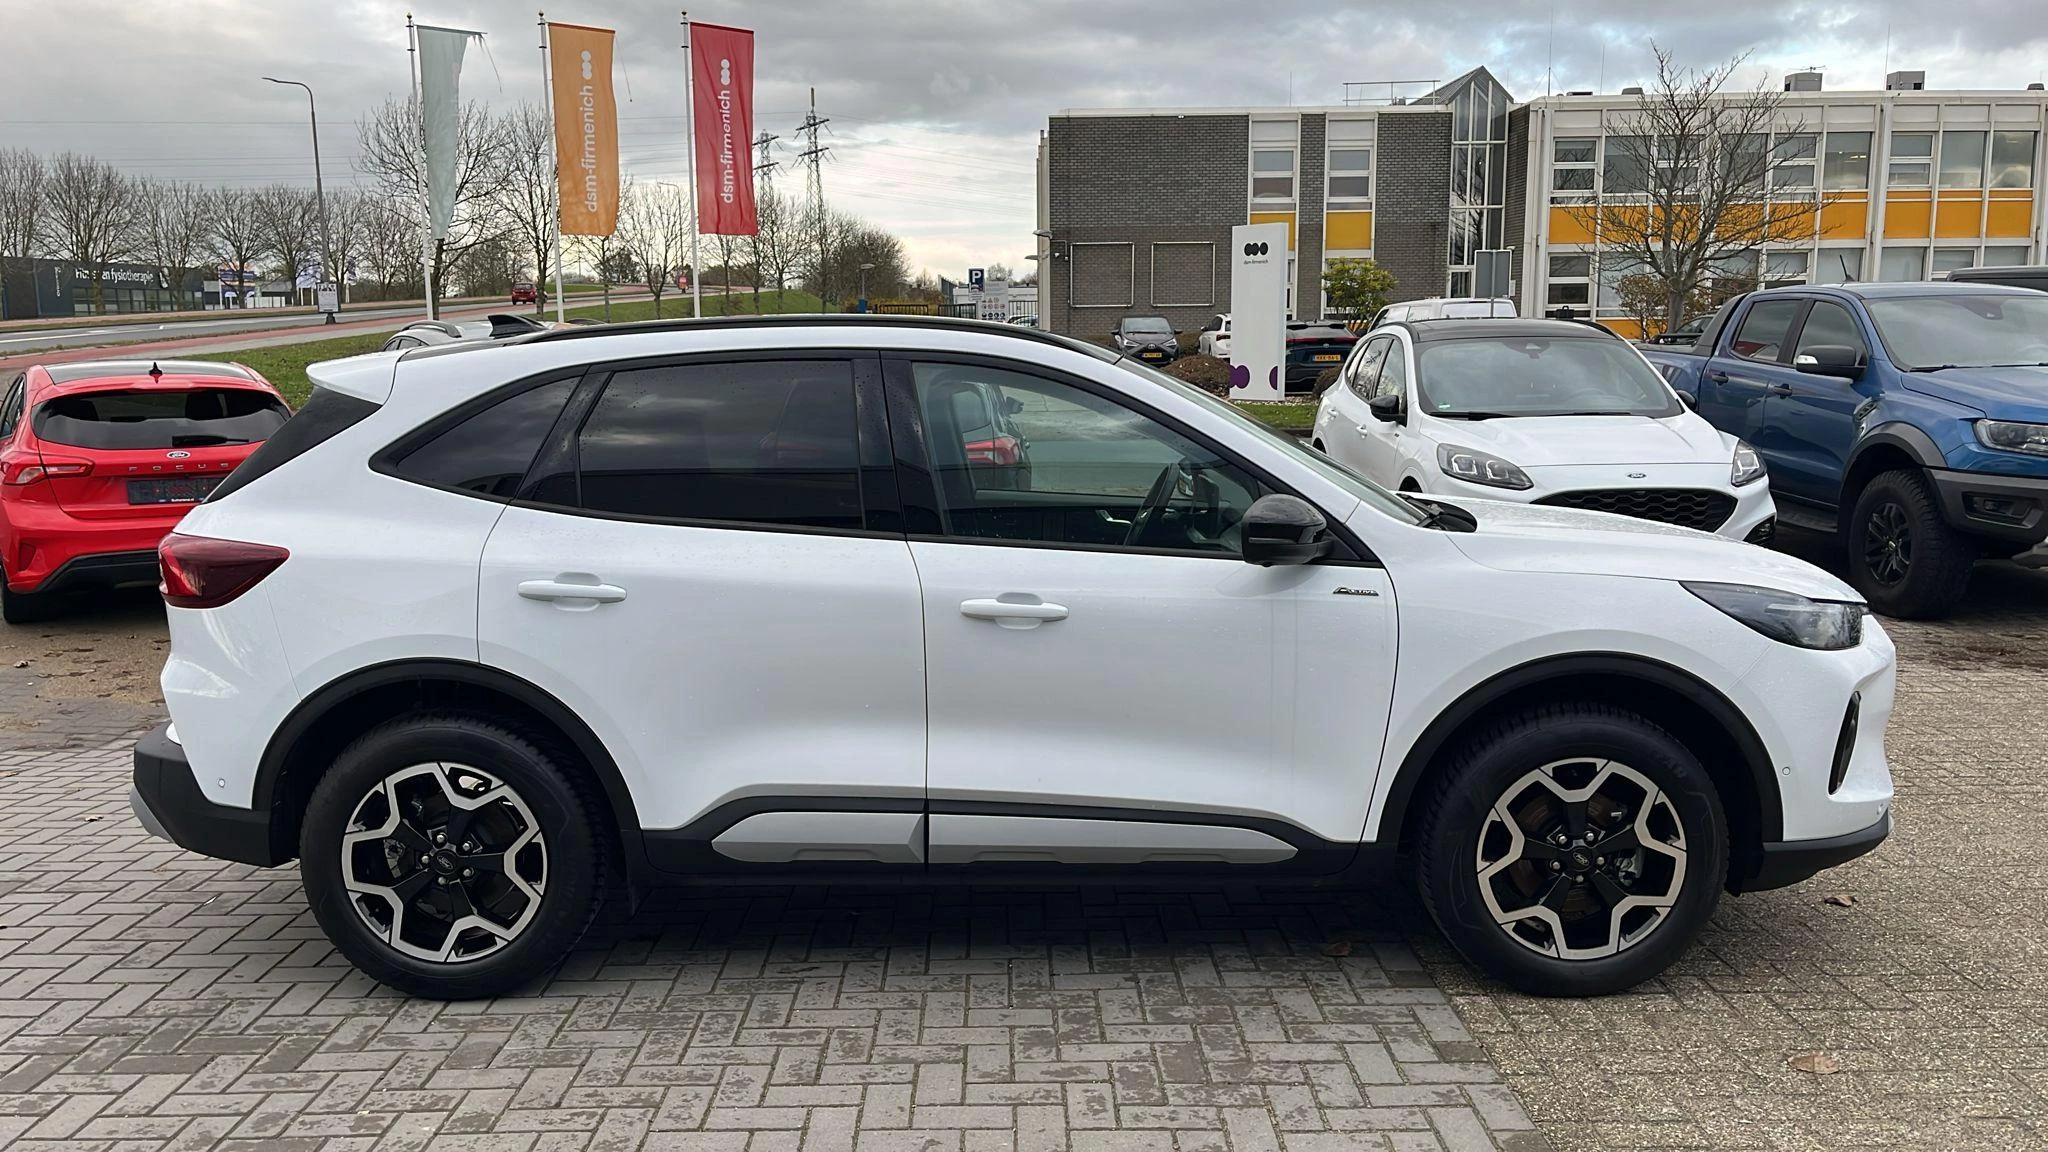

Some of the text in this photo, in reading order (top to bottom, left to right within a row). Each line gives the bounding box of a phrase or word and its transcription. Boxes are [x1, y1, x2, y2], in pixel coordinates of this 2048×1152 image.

[580, 85, 597, 212] dsm-firmenich
[718, 90, 734, 203] dsm-firmenich
[111, 267, 154, 285] fysiotherapie
[972, 271, 981, 283] P
[128, 463, 229, 471] FOCUS
